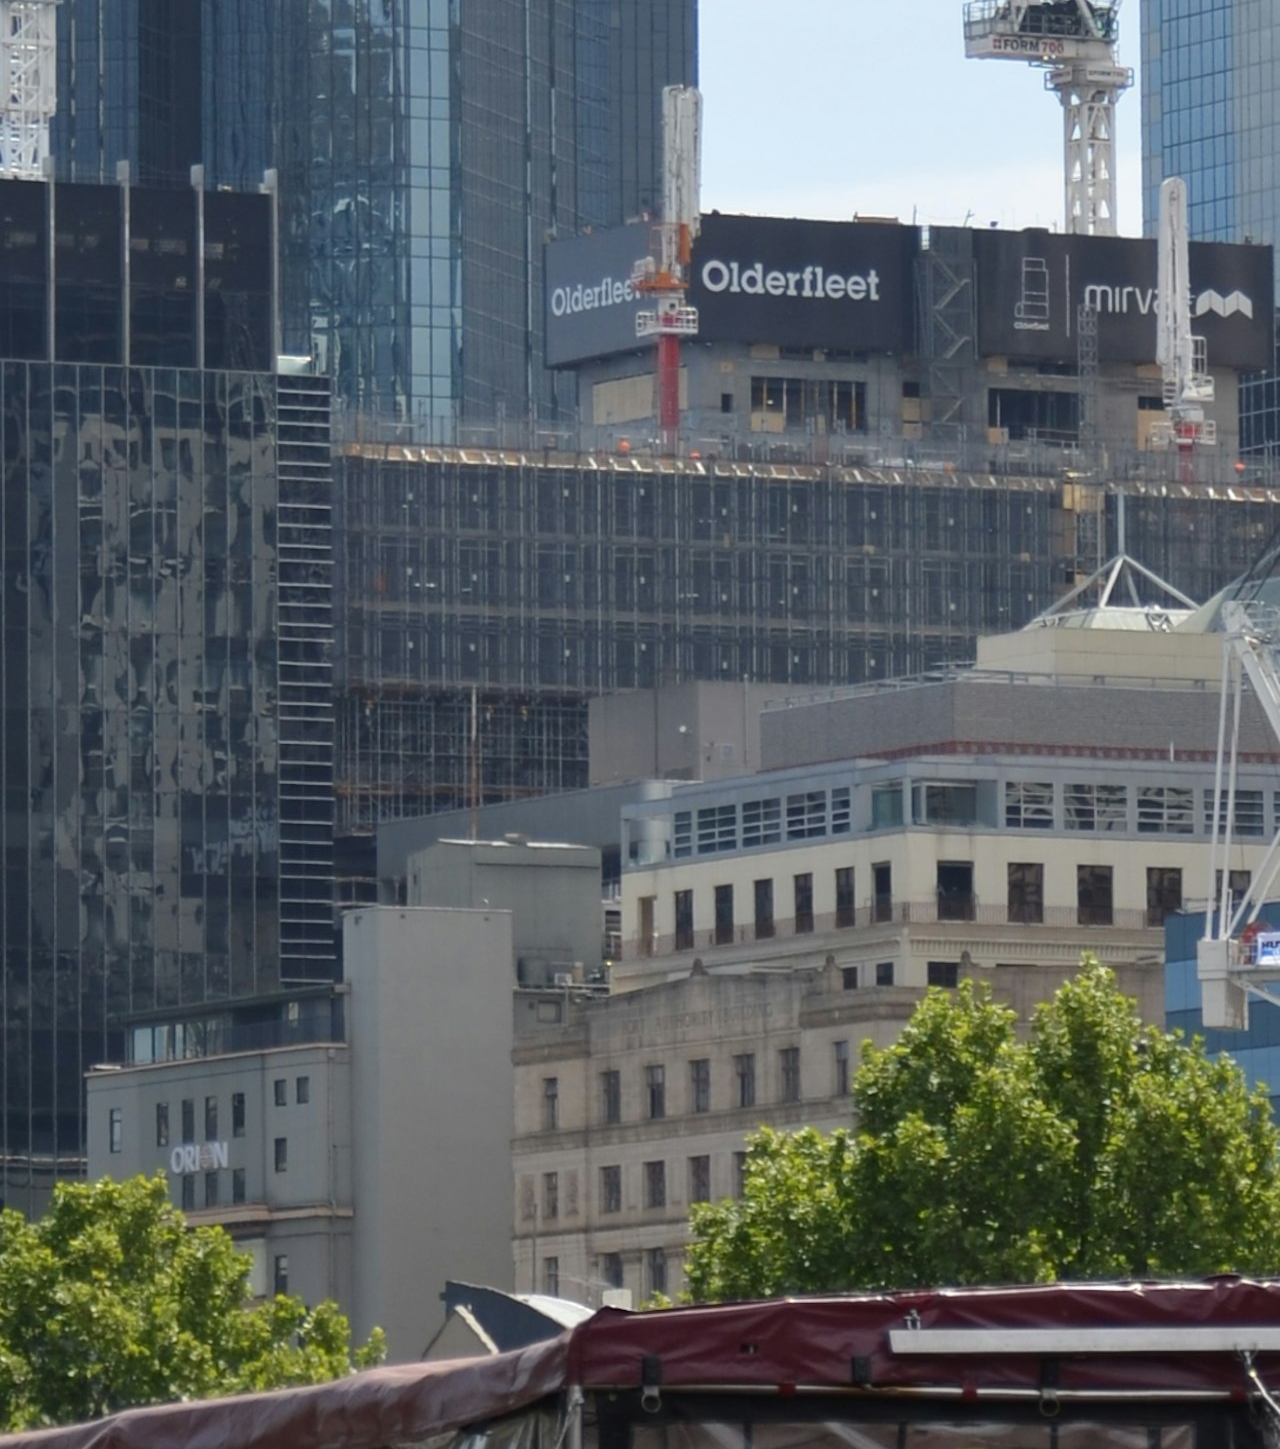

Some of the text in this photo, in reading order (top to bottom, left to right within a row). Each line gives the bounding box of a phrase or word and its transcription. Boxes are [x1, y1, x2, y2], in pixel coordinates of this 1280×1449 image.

[1003, 38, 1065, 54] FORM 700
[702, 259, 880, 301] Olderfleet
